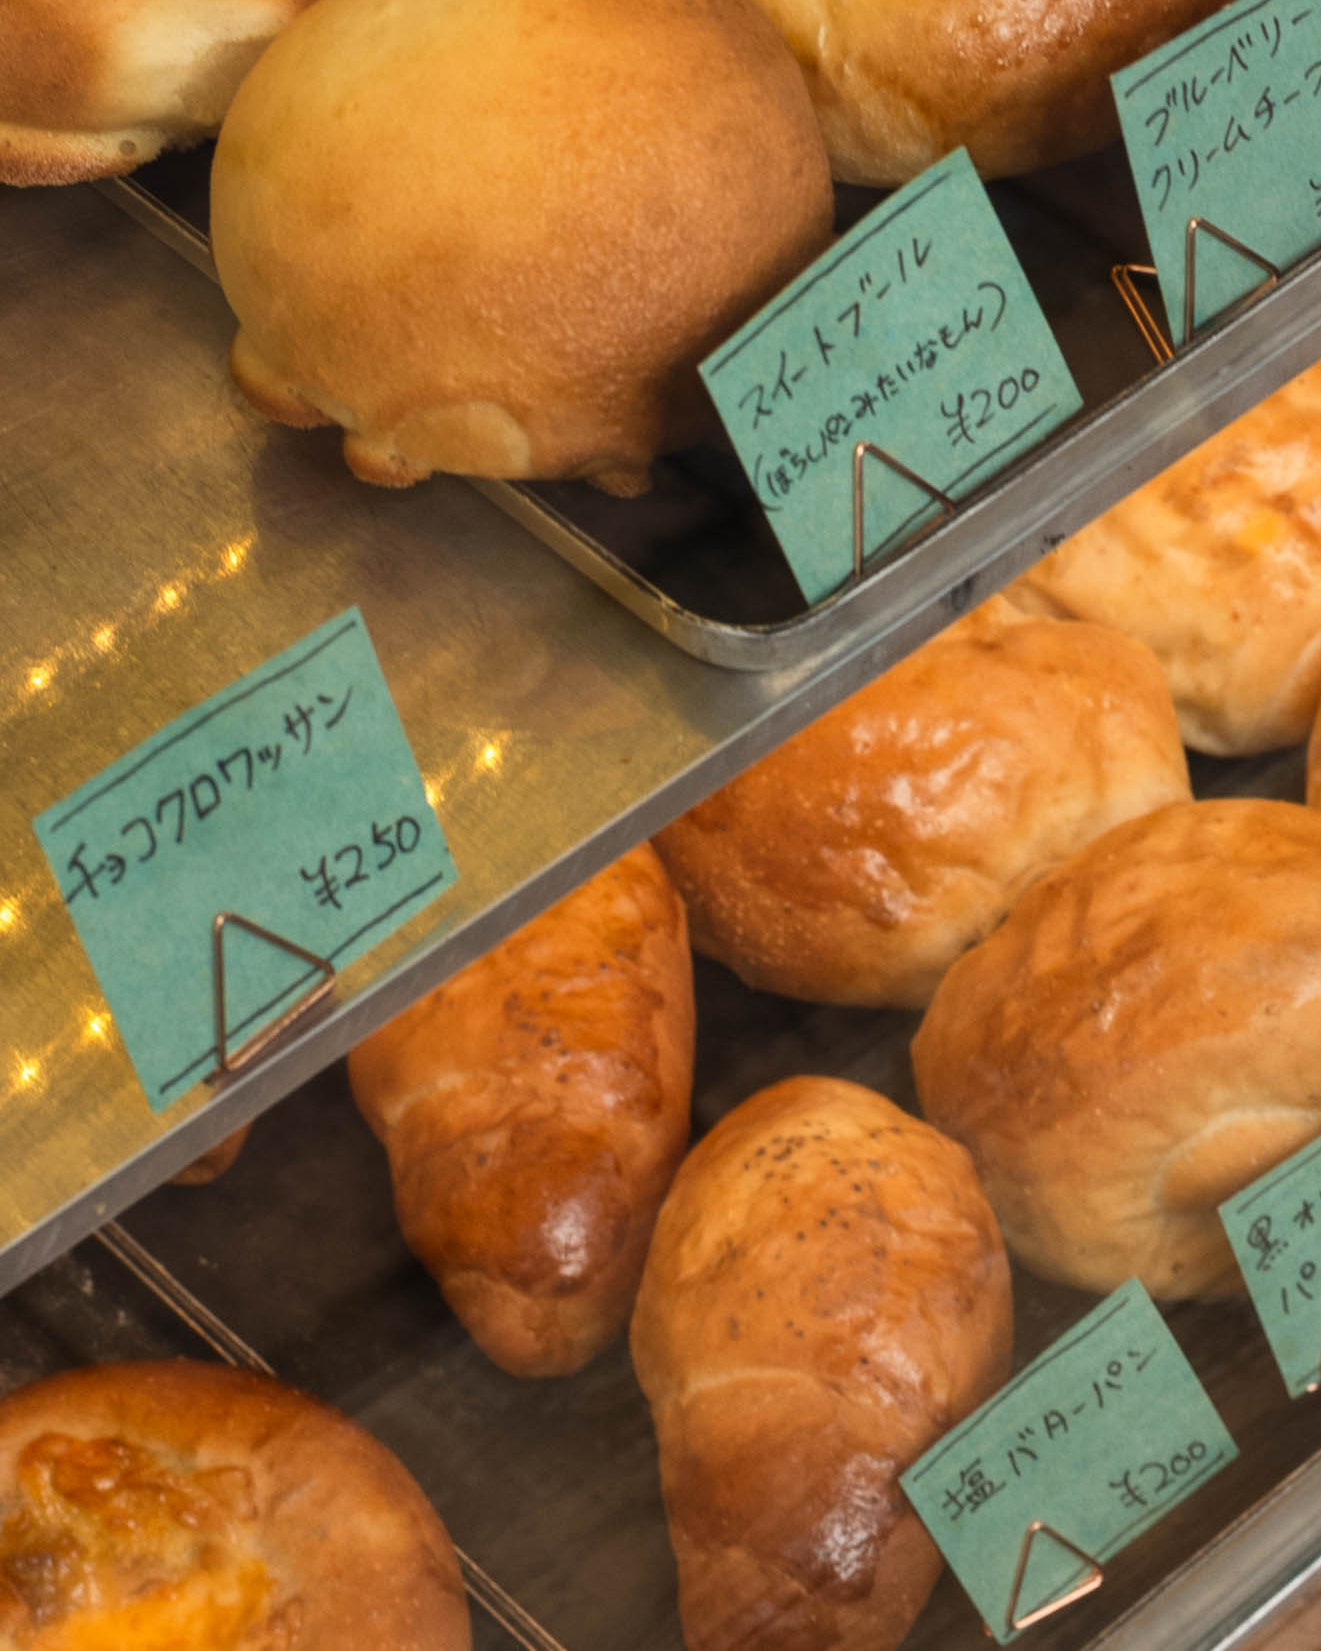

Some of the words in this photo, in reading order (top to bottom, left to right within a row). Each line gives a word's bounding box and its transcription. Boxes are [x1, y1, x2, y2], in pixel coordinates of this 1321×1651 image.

[739, 237, 932, 429] スイートブール
[940, 368, 1041, 446] ¥200
[65, 684, 354, 904] チョコクロワッサン
[300, 815, 421, 910] ¥250
[942, 1348, 1157, 1521] 塩バターパン
[1108, 1441, 1206, 1509] ¥200
